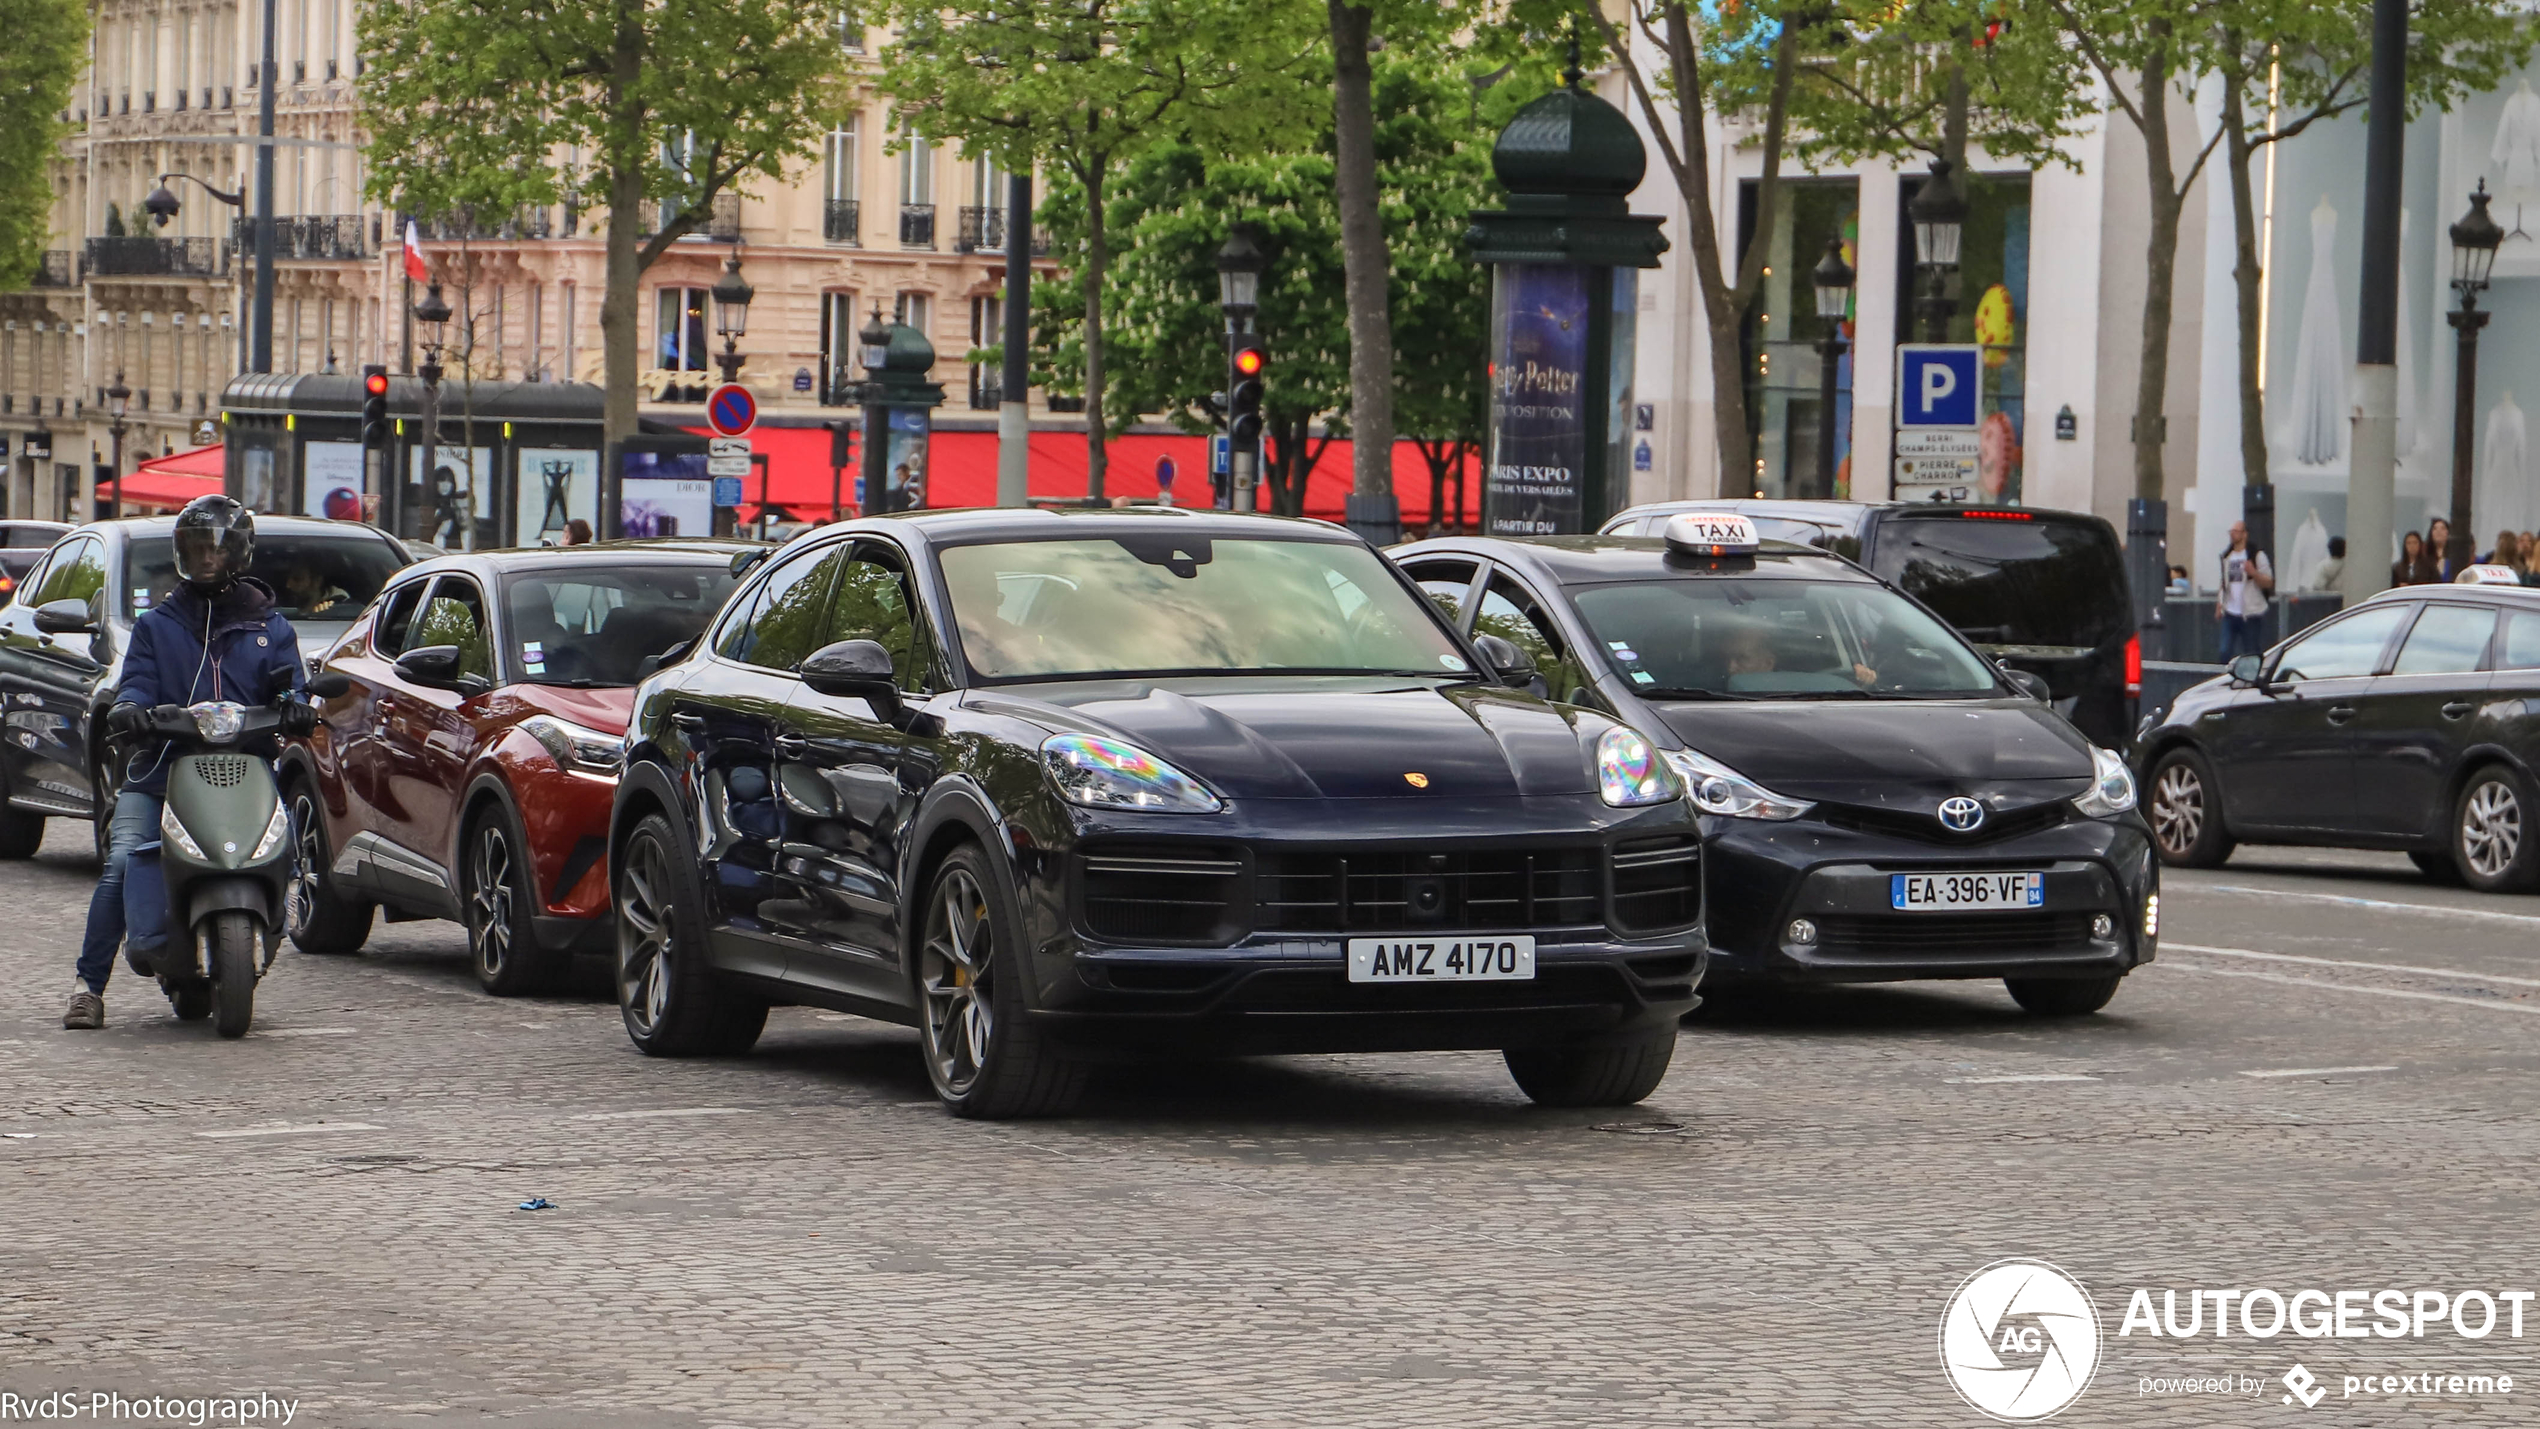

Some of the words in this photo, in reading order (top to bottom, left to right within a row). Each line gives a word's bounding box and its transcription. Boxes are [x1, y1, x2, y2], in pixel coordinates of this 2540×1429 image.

[1525, 360, 1579, 395] Potter
[1921, 362, 1956, 412] P
[1919, 460, 1956, 469] PIERRE
[1522, 466, 1571, 482] EXPO
[1913, 471, 1962, 480] CHARRON
[676, 482, 707, 493] DIOR
[1536, 521, 1556, 534] DU
[1694, 523, 1746, 537] TAXI
[2482, 568, 2509, 577] TAXI
[1907, 876, 2026, 904] EA-396-VF
[2028, 889, 2041, 902] 94
[1371, 943, 1436, 976] AMZ
[1445, 942, 1516, 975] 4170
